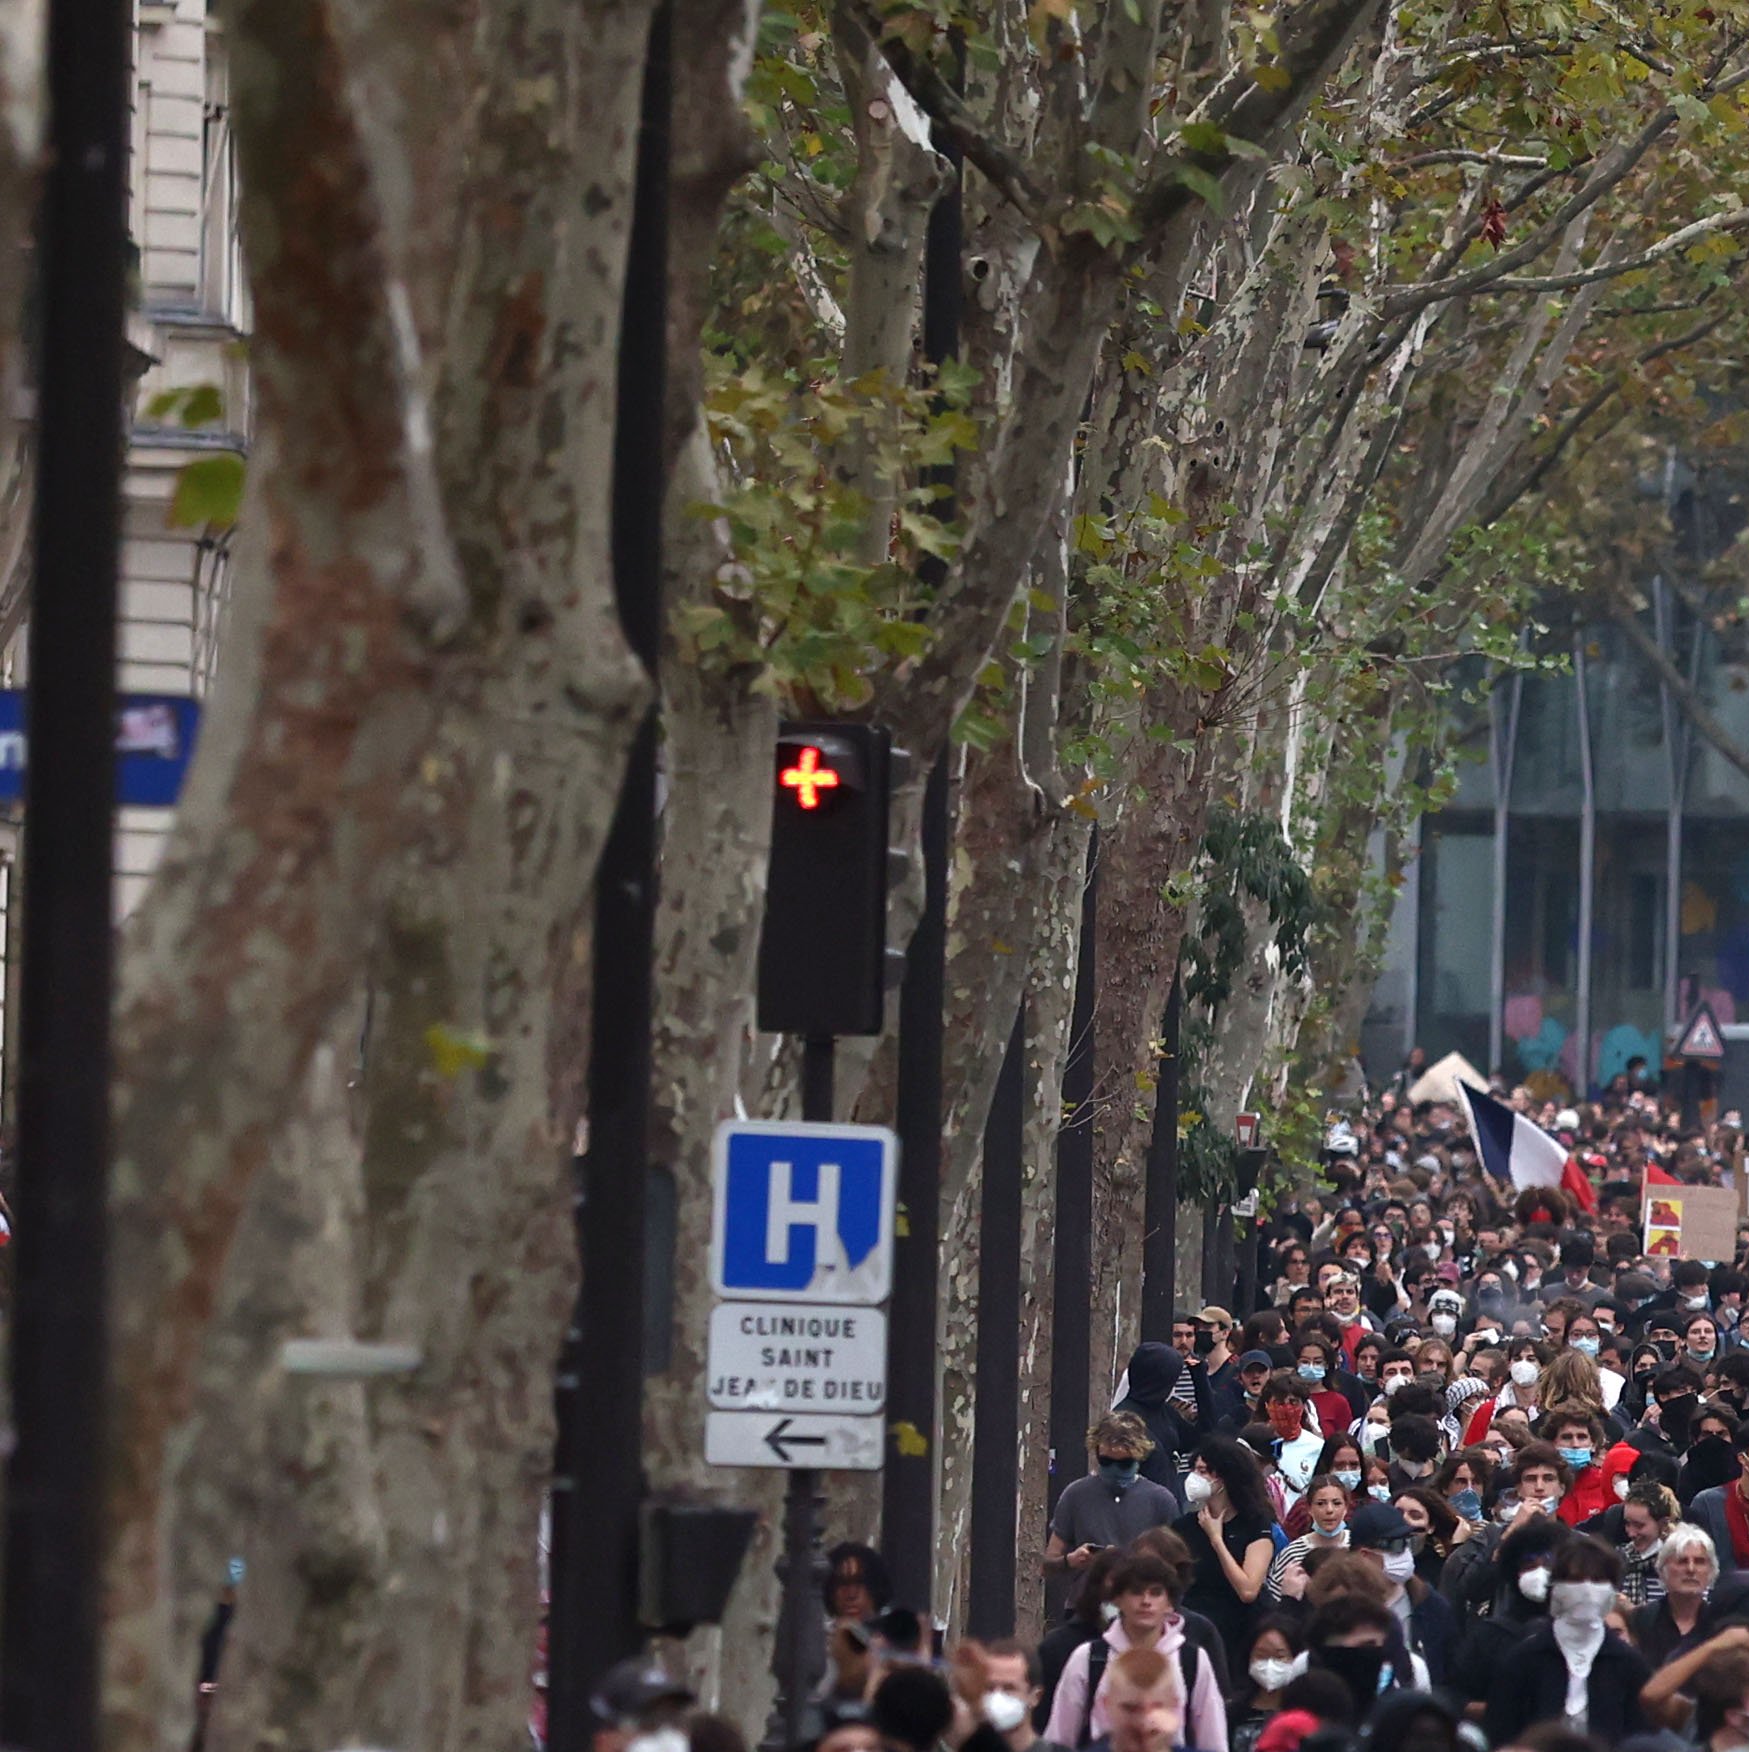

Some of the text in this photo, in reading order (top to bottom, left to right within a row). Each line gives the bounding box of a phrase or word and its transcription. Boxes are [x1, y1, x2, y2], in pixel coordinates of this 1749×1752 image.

[740, 1316, 856, 1339] CLINIQUE
[761, 1347, 834, 1368] SAINT
[711, 1376, 883, 1401] JEA DE DIEU
